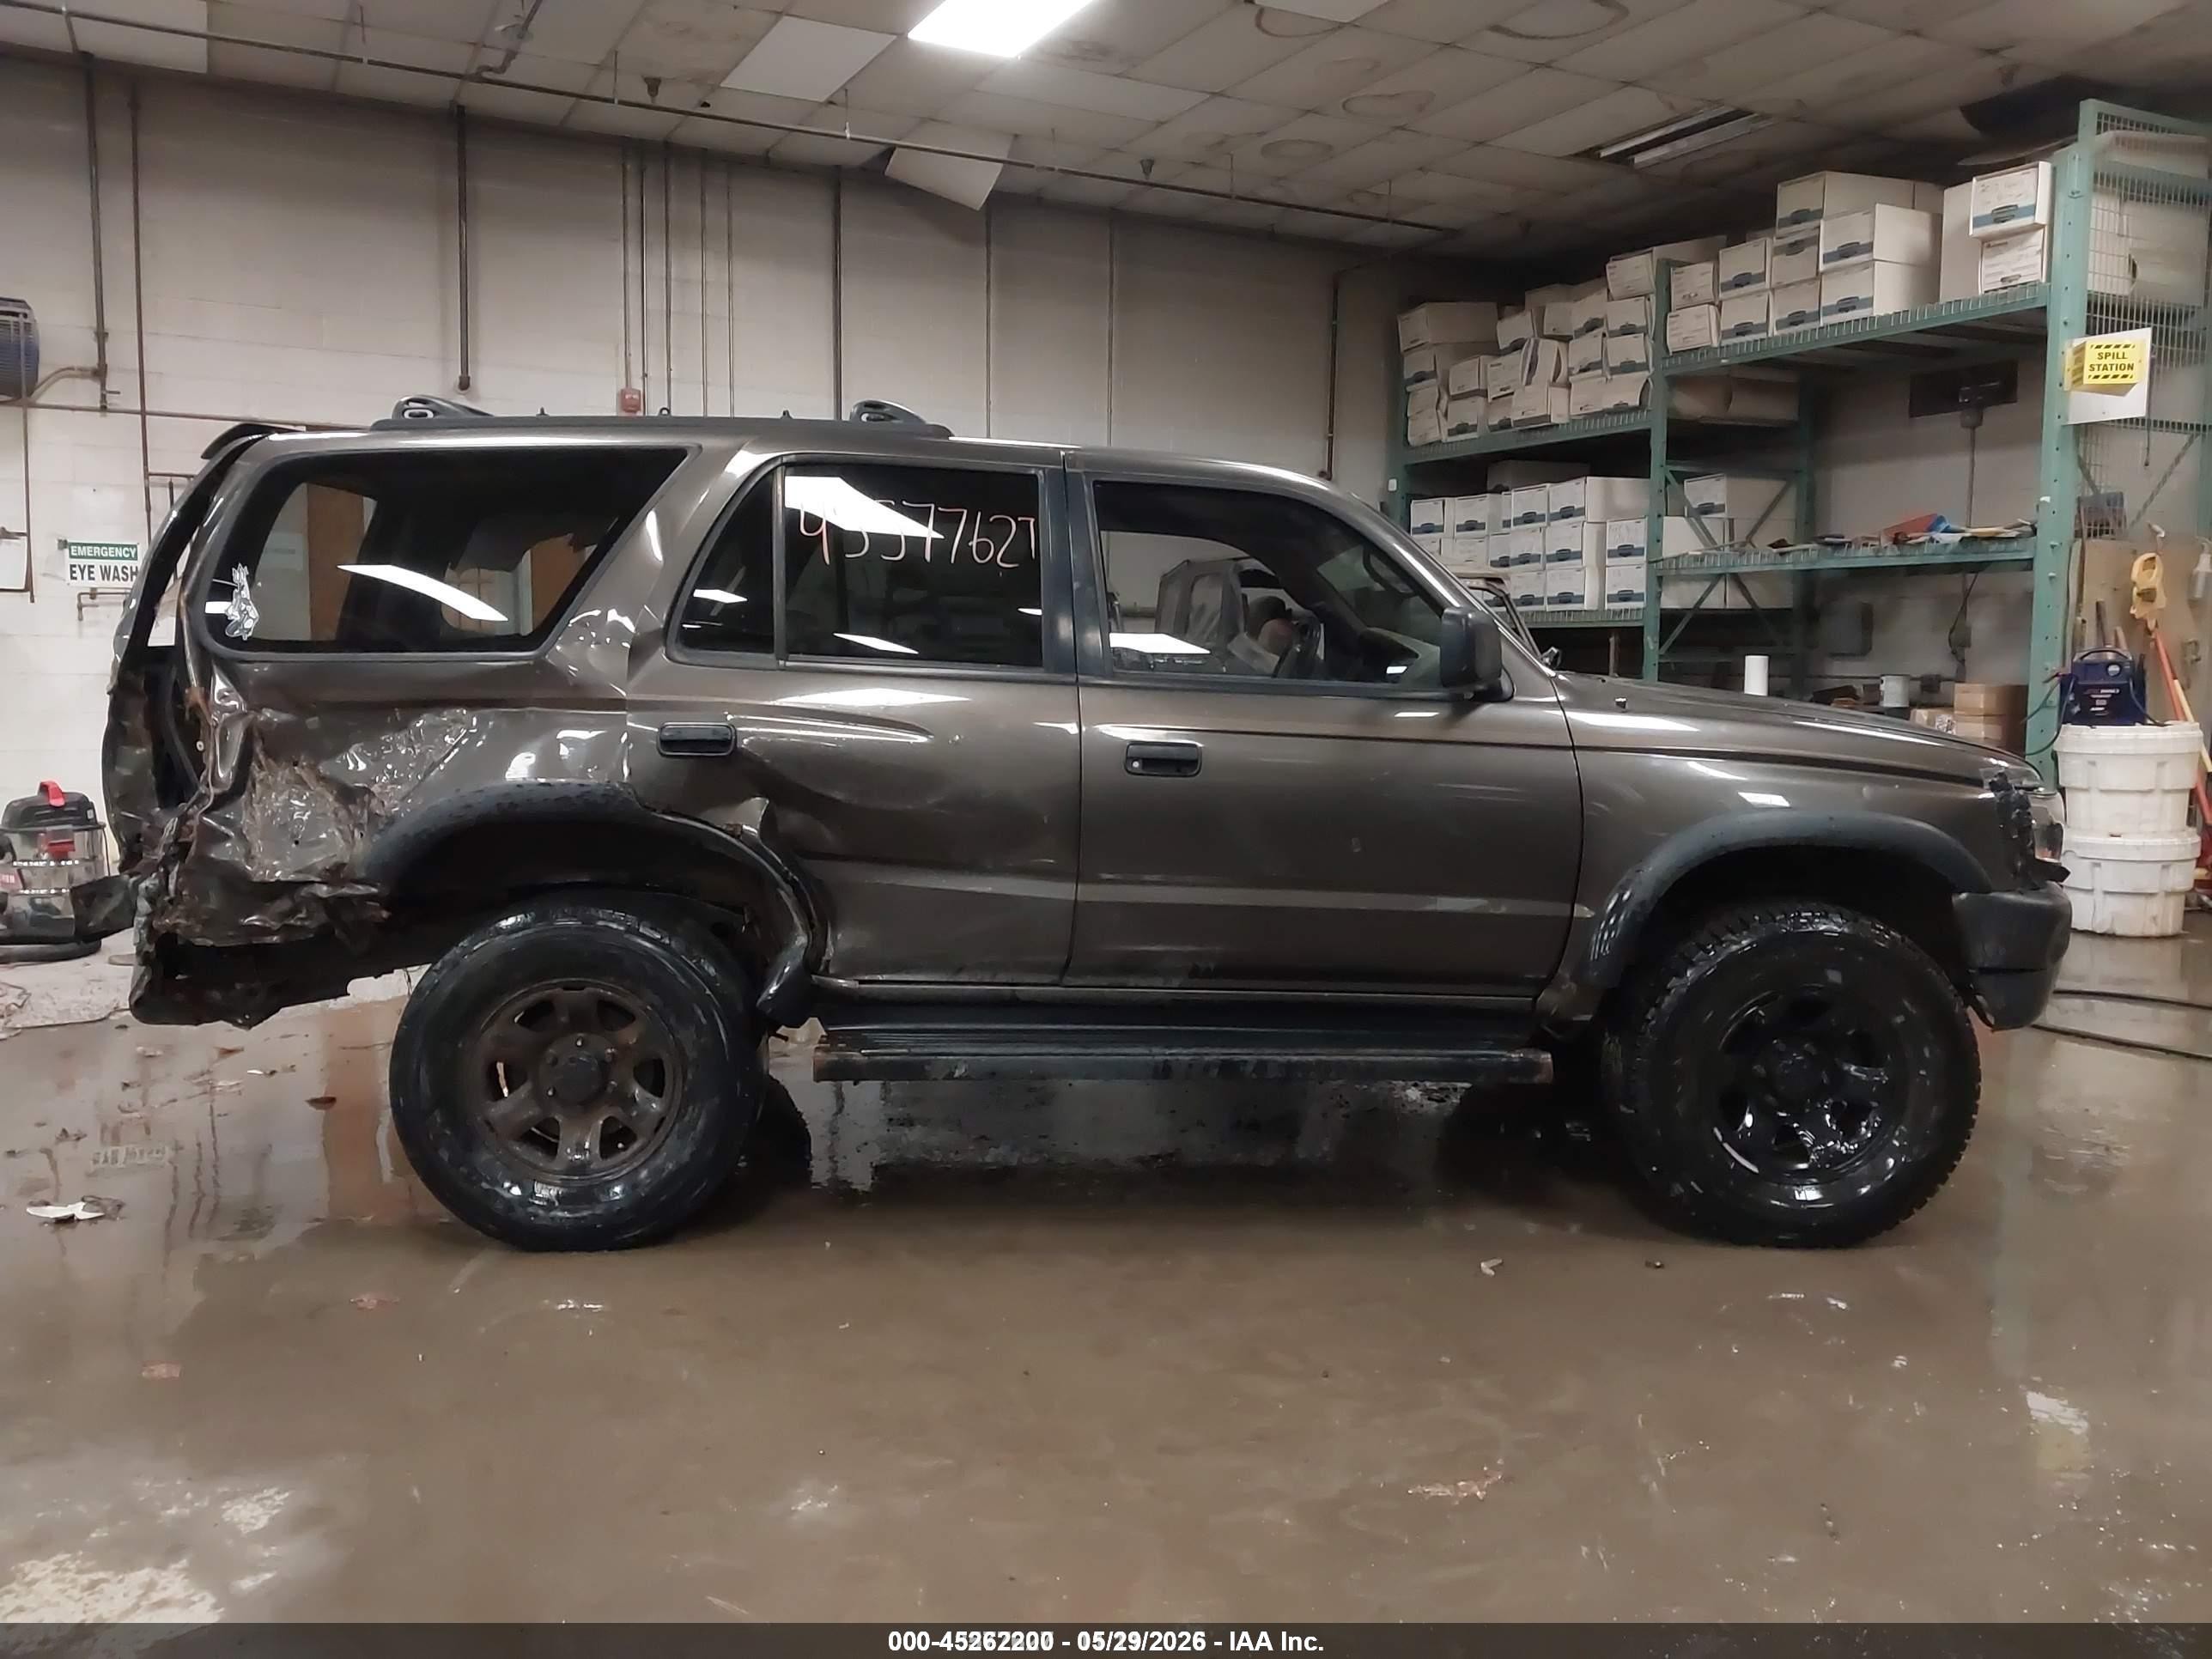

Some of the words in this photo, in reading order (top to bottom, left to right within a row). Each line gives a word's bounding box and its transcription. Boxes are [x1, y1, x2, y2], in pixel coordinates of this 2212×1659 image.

[2097, 351, 2128, 361] SPILL
[2088, 362, 2135, 372] STATION
[70, 545, 137, 558] EMERGENCY
[70, 563, 95, 581] EYE
[100, 564, 139, 582] WASH
